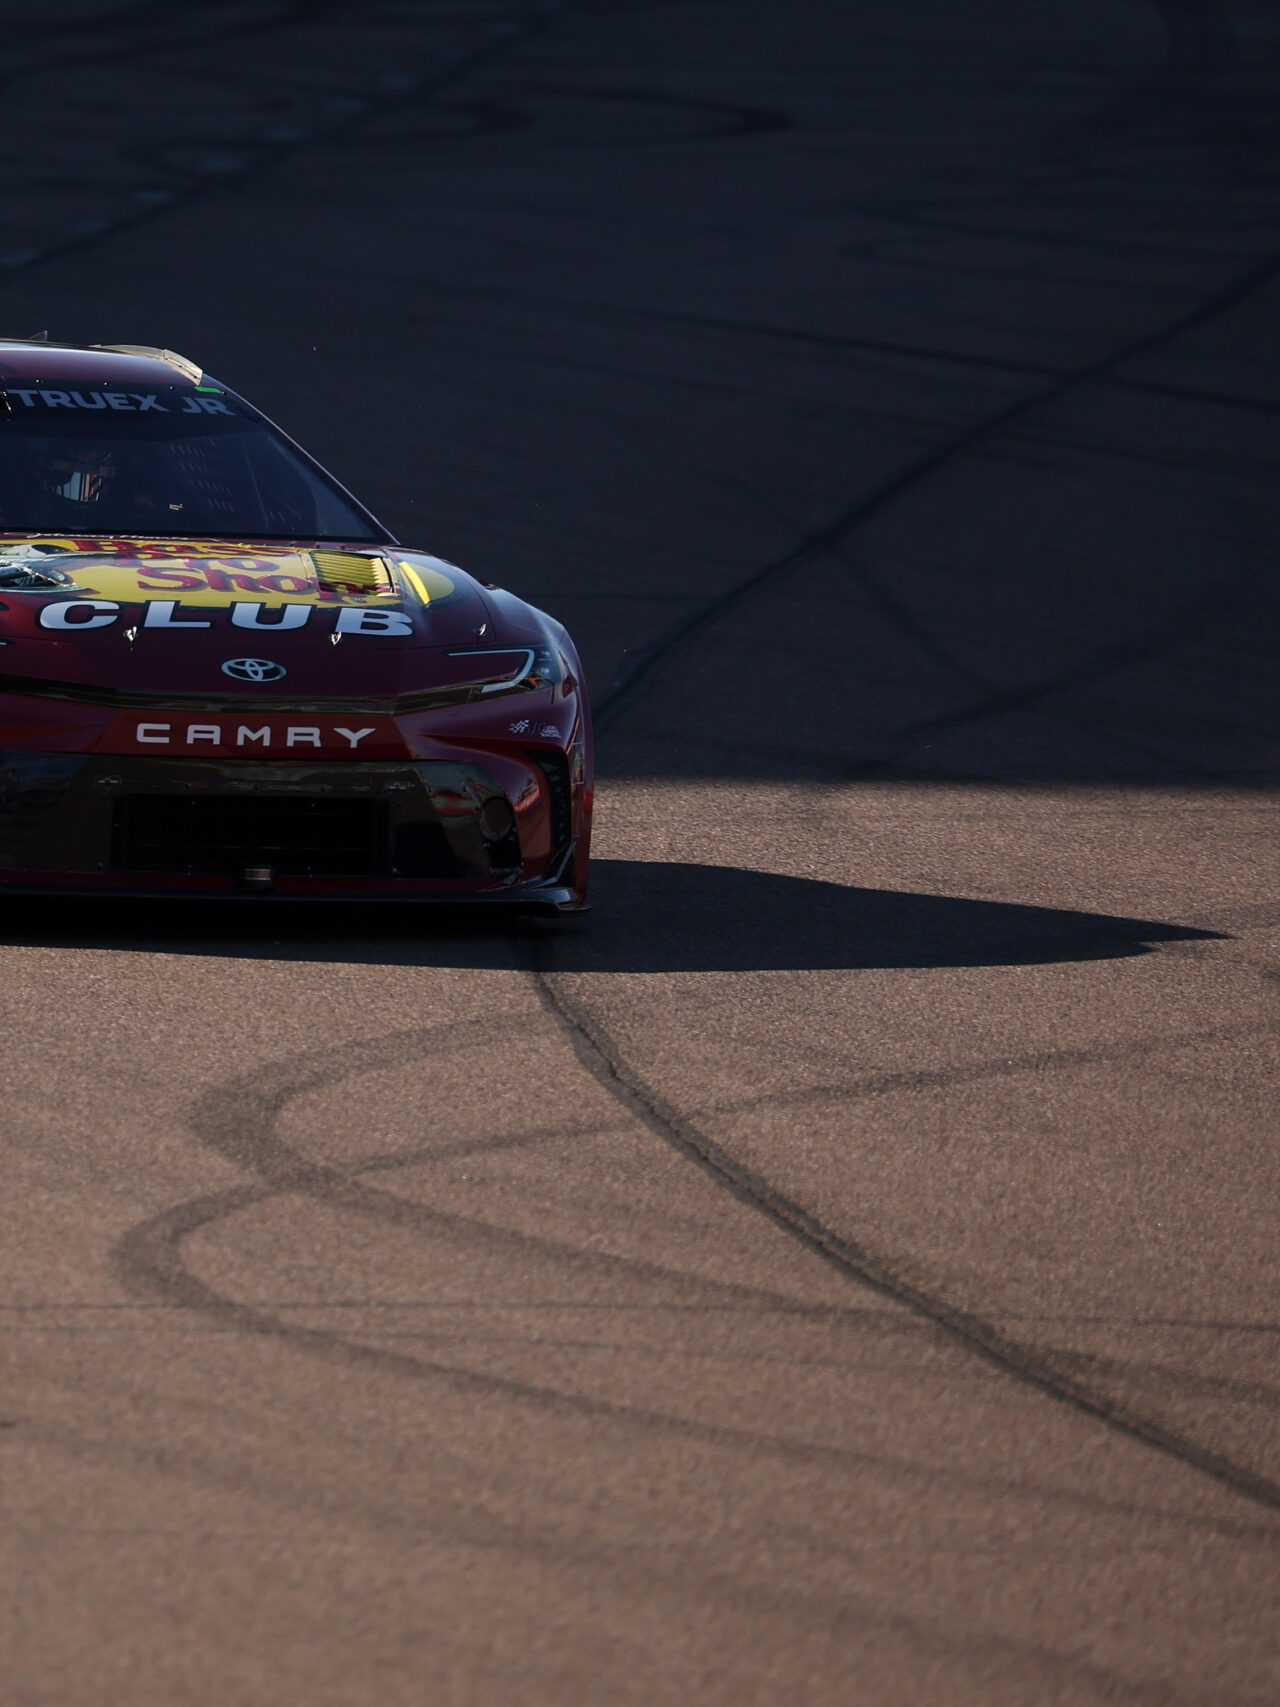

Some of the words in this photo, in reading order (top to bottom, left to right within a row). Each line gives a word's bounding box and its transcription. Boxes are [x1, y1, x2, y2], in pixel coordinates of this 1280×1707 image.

[7, 389, 170, 412] TRUEX
[182, 396, 237, 416] JR
[73, 539, 297, 557] Bass
[38, 600, 414, 638] CLUB
[136, 723, 376, 748] CAMRY
